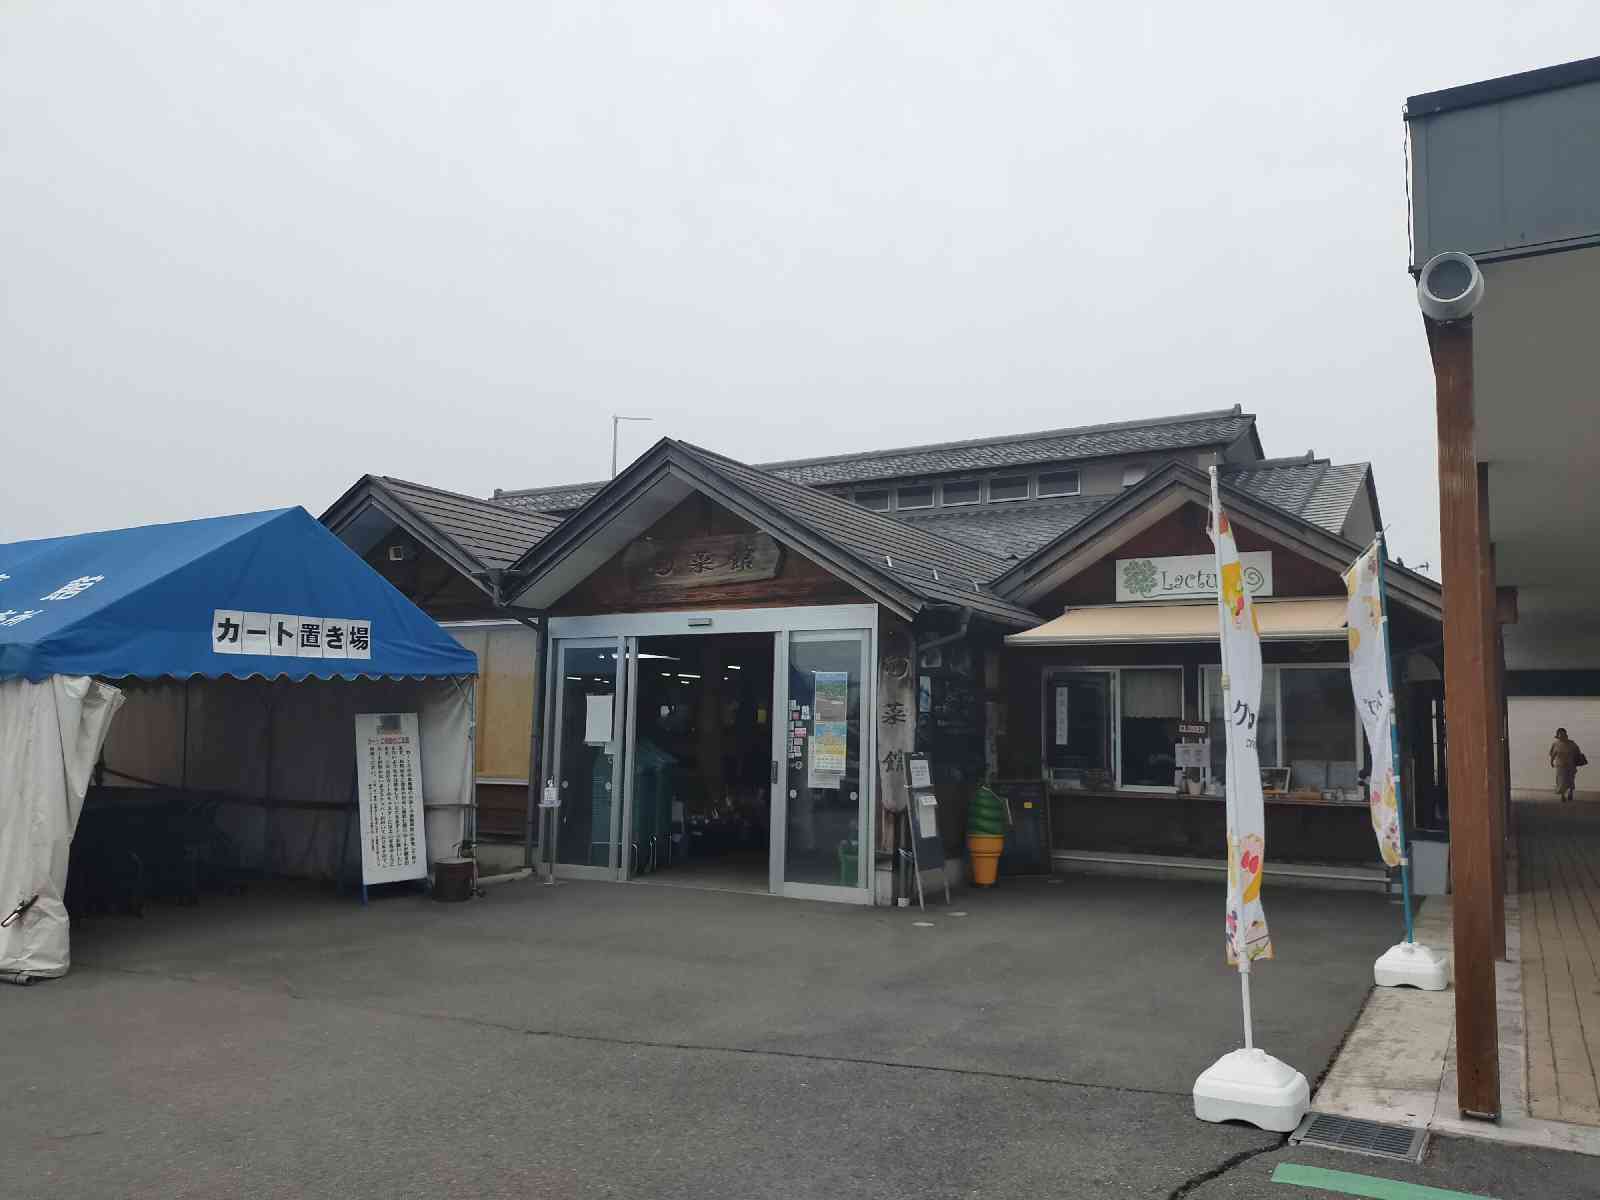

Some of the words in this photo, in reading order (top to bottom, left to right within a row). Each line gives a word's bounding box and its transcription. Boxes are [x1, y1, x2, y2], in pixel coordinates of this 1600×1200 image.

[217, 618, 369, 651] カート置き場
